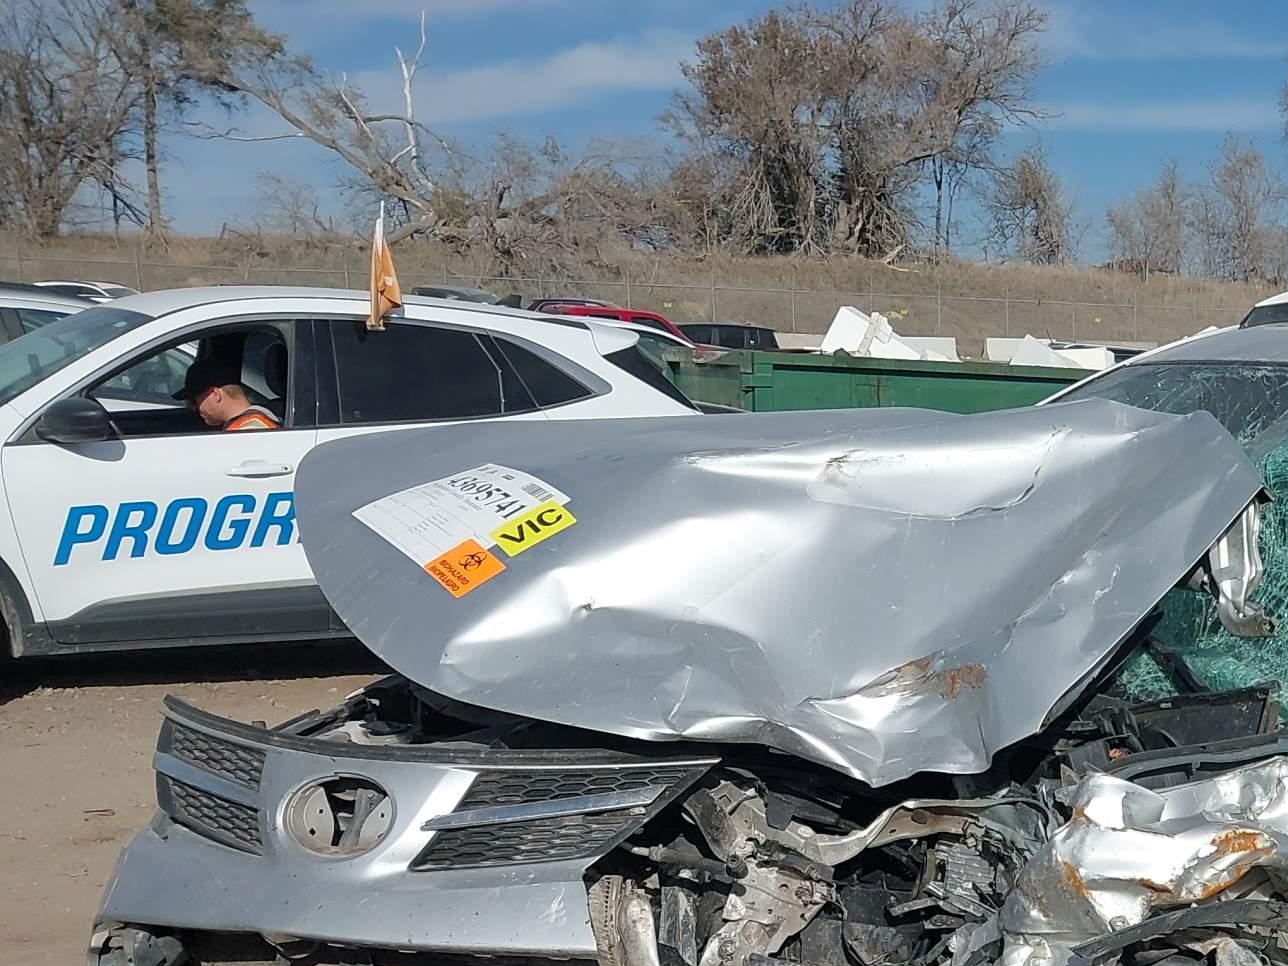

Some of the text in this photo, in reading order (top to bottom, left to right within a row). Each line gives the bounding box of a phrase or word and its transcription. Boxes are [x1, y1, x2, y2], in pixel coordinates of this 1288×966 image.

[447, 476, 527, 519] 43695741
[53, 491, 302, 567] PROGR
[500, 508, 563, 543] VIC
[440, 559, 470, 586] BIOHAZARD
